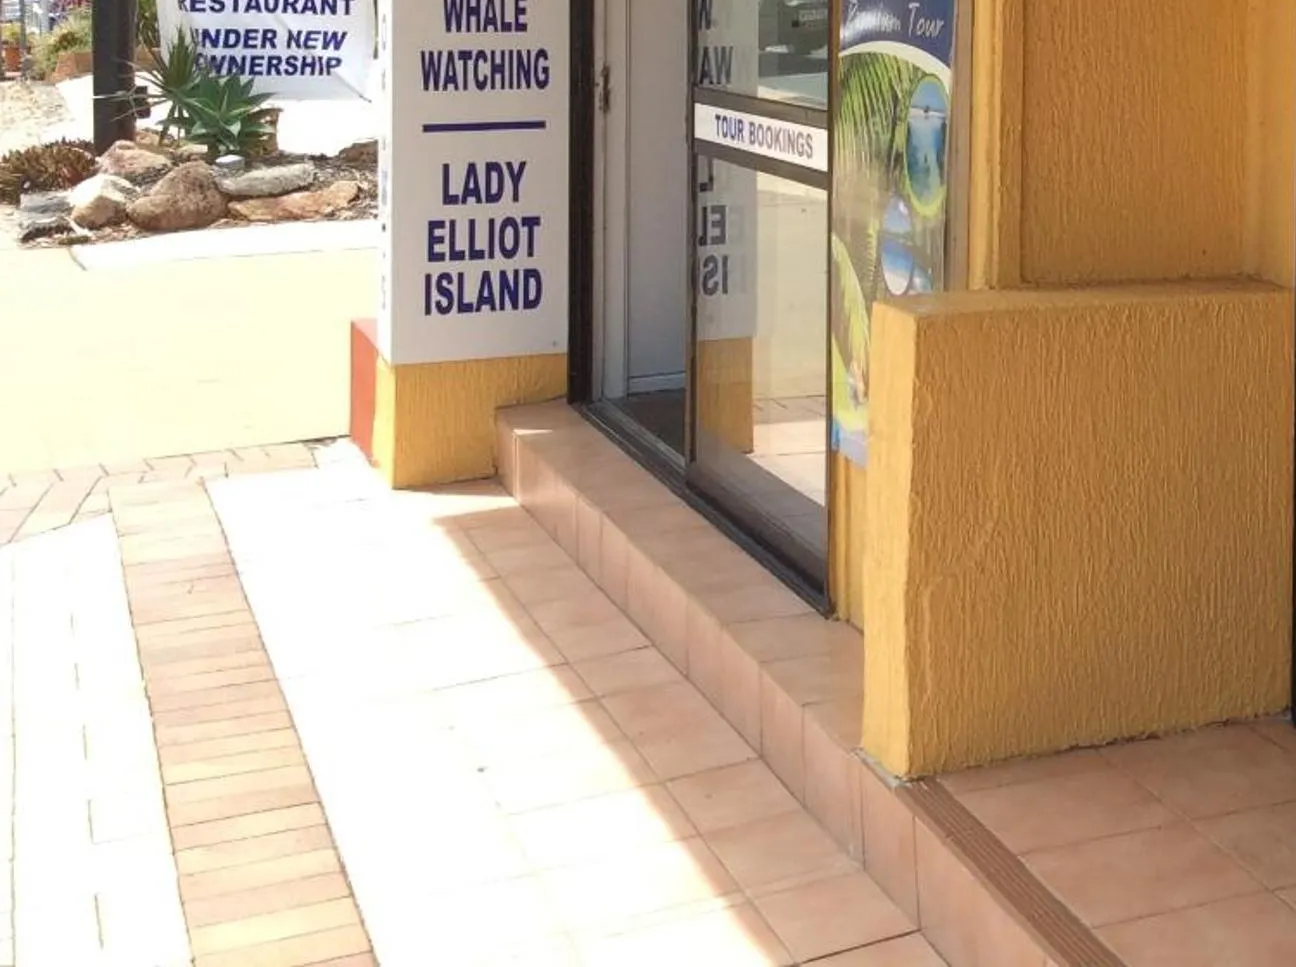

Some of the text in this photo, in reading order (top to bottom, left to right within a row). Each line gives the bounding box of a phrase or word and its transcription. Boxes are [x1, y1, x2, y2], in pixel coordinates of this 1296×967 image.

[194, 28, 349, 51] NDER NEW
[908, 2, 945, 38] Tour
[420, 48, 550, 91] WATCHING
[715, 113, 814, 159] TOUR BOOKINGS
[442, 161, 528, 206] LADY
[427, 216, 541, 263] ELLIOT
[424, 267, 544, 317] ISLAND
